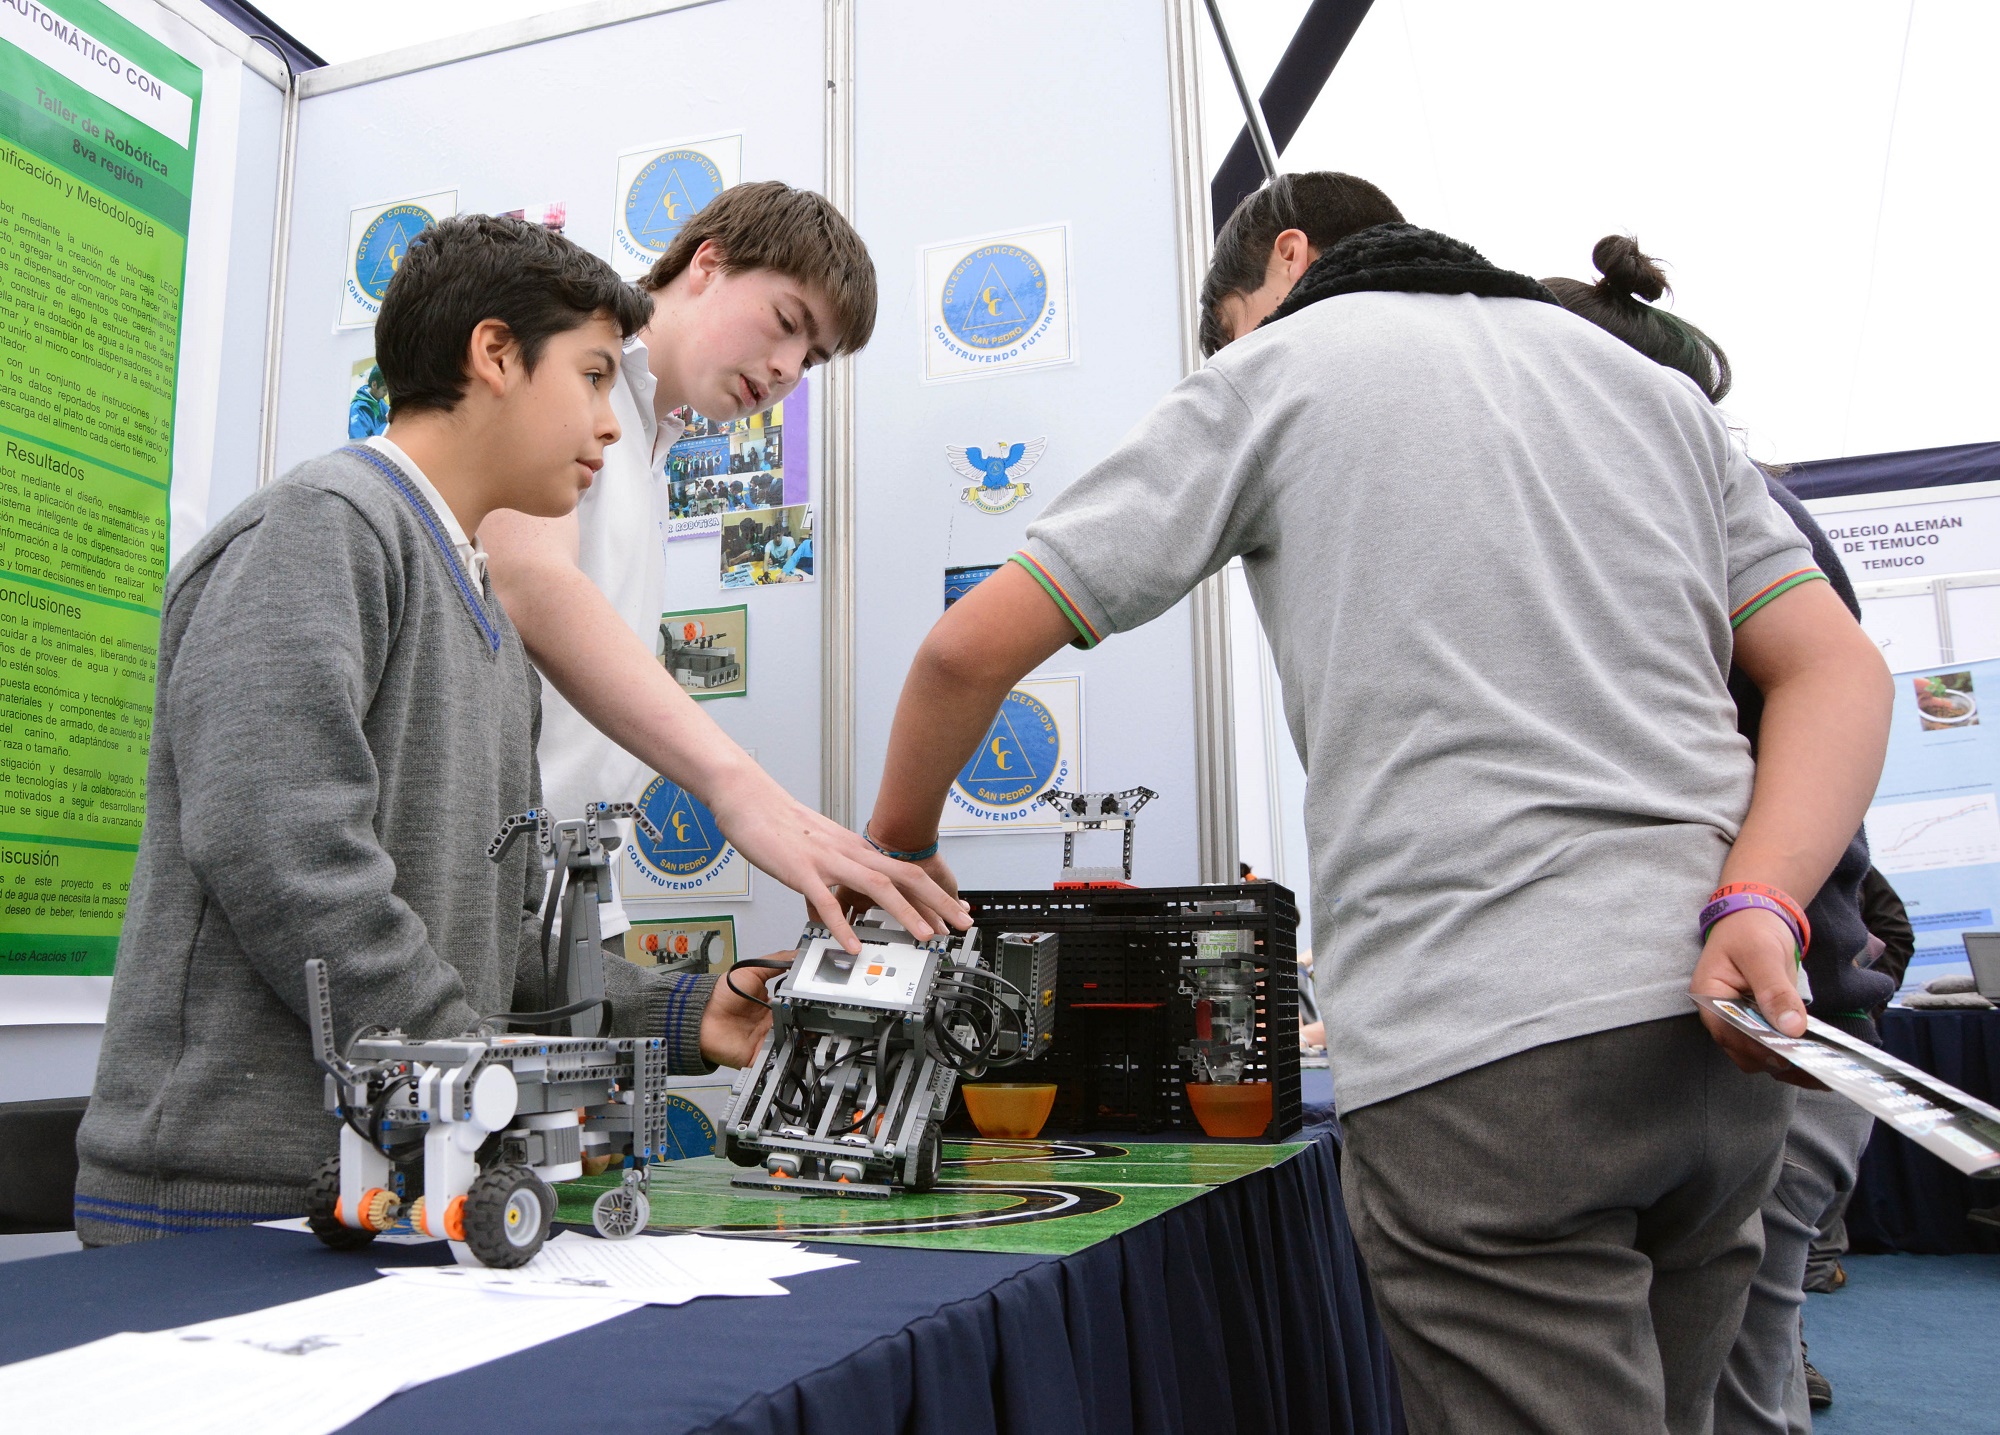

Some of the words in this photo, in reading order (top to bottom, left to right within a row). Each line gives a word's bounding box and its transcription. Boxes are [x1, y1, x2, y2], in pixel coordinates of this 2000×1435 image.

[126, 68, 162, 100] CON
[36, 87, 78, 124] Taller
[82, 118, 100, 138] de
[105, 128, 168, 177] Robótica
[73, 139, 96, 164] 8va
[101, 158, 143, 188] región
[629, 164, 656, 208] COLEGIO
[661, 152, 718, 183] CONCEPCION
[66, 184, 73, 197] y
[78, 186, 154, 238] Metodología
[14, 223, 50, 246] permitan
[69, 250, 102, 271] creación
[22, 212, 60, 236] mediante
[82, 241, 103, 258] unión
[127, 262, 155, 283] bloques
[161, 280, 178, 297] LEGO
[359, 217, 384, 259] COLEGIO
[650, 238, 665, 248] SAN
[20, 240, 52, 261] agregar
[72, 265, 116, 291] servomotor
[946, 258, 973, 304] COLEGIO
[977, 247, 1041, 277] CONCEPCION
[14, 268, 50, 290] raciones
[71, 292, 108, 315] alimentos
[24, 256, 75, 286] dispensador
[122, 302, 176, 336] compartimientos
[11, 280, 48, 302] construir
[69, 305, 85, 319] lego
[103, 321, 140, 343] estructura
[34, 321, 78, 344] ensamblar
[99, 346, 152, 377] dispensadores
[48, 311, 82, 332] dotación
[98, 334, 116, 348] agua
[136, 350, 163, 369] mascota
[934, 325, 1018, 362] CONSTRUYENDO
[971, 334, 989, 344] SAN
[991, 326, 1022, 344] PEDRO
[8, 325, 32, 340] unirlo
[46, 340, 68, 354] micro
[71, 350, 114, 374] controlador
[140, 380, 171, 400] estructura
[29, 379, 52, 395] datos
[58, 391, 100, 413] reportados
[134, 421, 157, 436] sensor
[46, 372, 81, 391] conjunto
[102, 392, 149, 420] instrucciones
[20, 391, 51, 409] cuando
[64, 407, 83, 422] plato
[99, 421, 124, 438] comida
[128, 430, 142, 444] esté
[53, 417, 87, 437] alimento
[90, 432, 107, 445] cada
[110, 439, 130, 453] cierto
[133, 447, 157, 465] tiempo.
[7, 441, 85, 481] Resultados
[21, 473, 60, 493] mediante
[78, 491, 103, 509] diseño,
[109, 502, 150, 523] ensamblaje
[34, 492, 74, 512] aplicación
[102, 514, 148, 536] matemáticas
[19, 518, 59, 536] mecánica
[91, 538, 147, 562] dispensadores
[37, 506, 78, 528] inteligente
[98, 527, 144, 548] alimentación
[1844, 542, 1865, 553] DE
[1869, 534, 1939, 550] TEMUCO
[1894, 516, 1962, 533] ALEMÁN
[16, 546, 51, 566] proceso,
[61, 559, 106, 580] permitiendo
[115, 574, 144, 589] realizar
[16, 561, 40, 576] tomar
[43, 567, 84, 588] decisiones
[99, 584, 126, 599] tiempo
[129, 592, 145, 603] real.
[72, 548, 120, 570] computadora
[138, 566, 164, 580] control
[1862, 555, 1924, 570] TEMUCO
[1, 628, 28, 641] cuidar
[57, 640, 96, 657] animales,
[101, 648, 136, 665] liberando
[33, 618, 96, 642] implementación
[117, 639, 157, 656] alimentador
[10, 661, 33, 673] estén
[36, 666, 60, 679] solos.
[36, 652, 66, 665] proveer
[88, 662, 108, 673] agua
[122, 668, 145, 682] comida
[34, 684, 79, 700] económica
[91, 692, 152, 714] tecnológicamente
[60, 703, 116, 720] componentes
[4, 740, 22, 751] raza
[34, 743, 70, 757] tamaño.
[25, 727, 56, 741] canino,
[69, 733, 119, 750] adaptándose
[60, 718, 95, 733] armado,
[110, 726, 136, 741] acuerdo
[16, 774, 68, 790] tecnologías
[91, 784, 136, 800] colaboración
[64, 765, 101, 779] desarrollo
[108, 771, 133, 786] logrado
[978, 787, 997, 801] SAN
[1000, 784, 1032, 801] PEDRO
[5, 789, 51, 802] motivados
[72, 798, 94, 809] seguir
[36, 806, 59, 820] sigue
[102, 816, 142, 828] avanzando
[627, 845, 702, 890] CONSTRUYENDO
[660, 859, 677, 871] SAN
[679, 856, 707, 871] PEDRO
[18, 892, 38, 902] agua
[59, 893, 90, 904] necesita
[35, 876, 52, 886] este
[61, 879, 94, 891] proyecto
[5, 905, 30, 915] deseo
[51, 907, 74, 918] beber,
[80, 909, 113, 919] teniendo
[8, 952, 27, 961] Los
[28, 951, 66, 962] Acacios
[71, 951, 87, 961] 107
